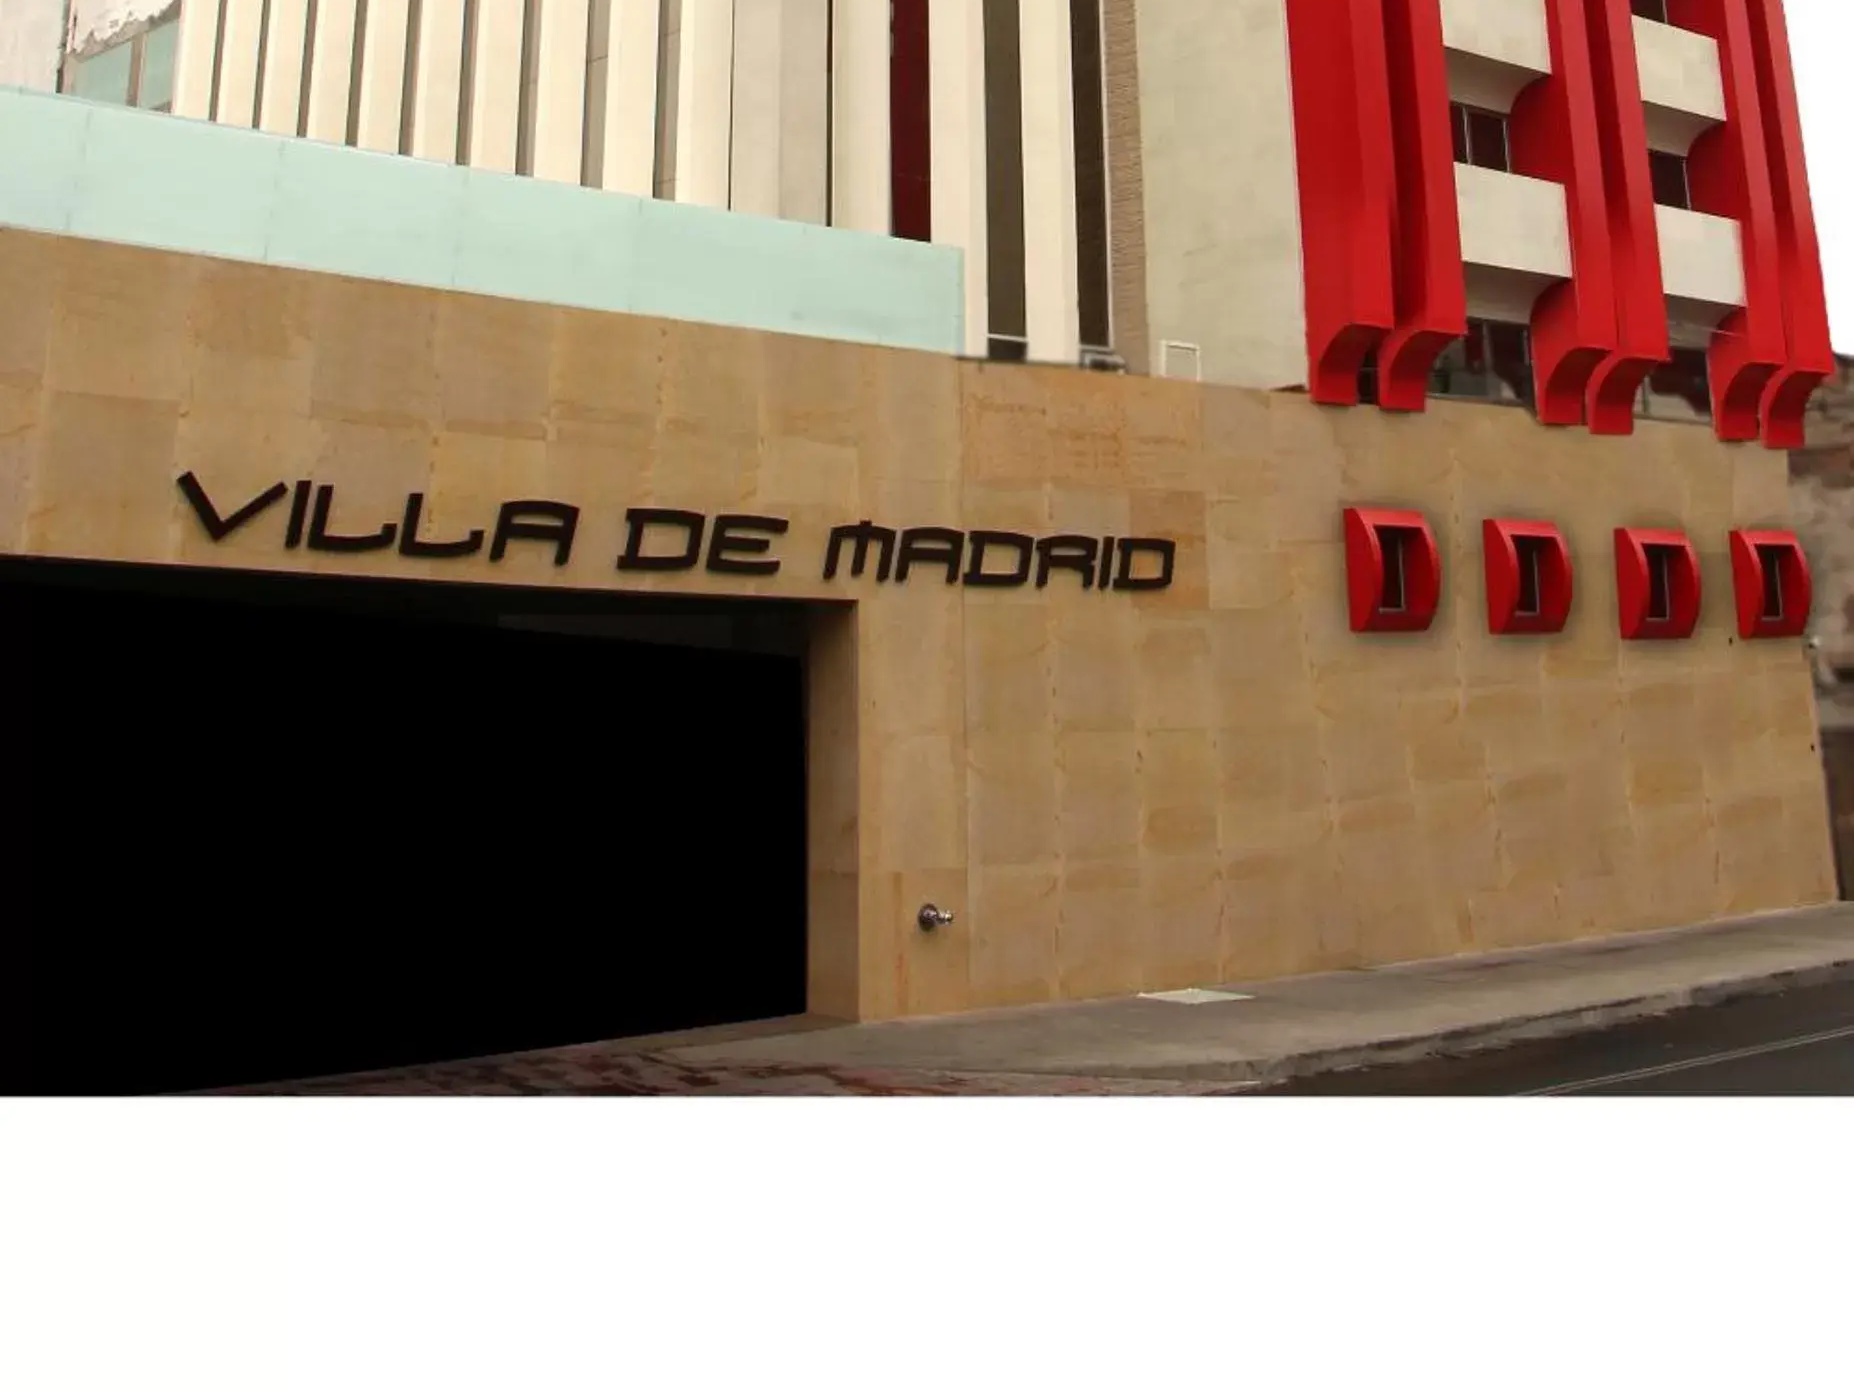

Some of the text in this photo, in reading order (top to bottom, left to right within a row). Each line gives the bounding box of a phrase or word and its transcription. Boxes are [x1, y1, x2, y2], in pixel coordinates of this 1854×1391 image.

[176, 470, 1177, 592] VILLA DE MADRID
